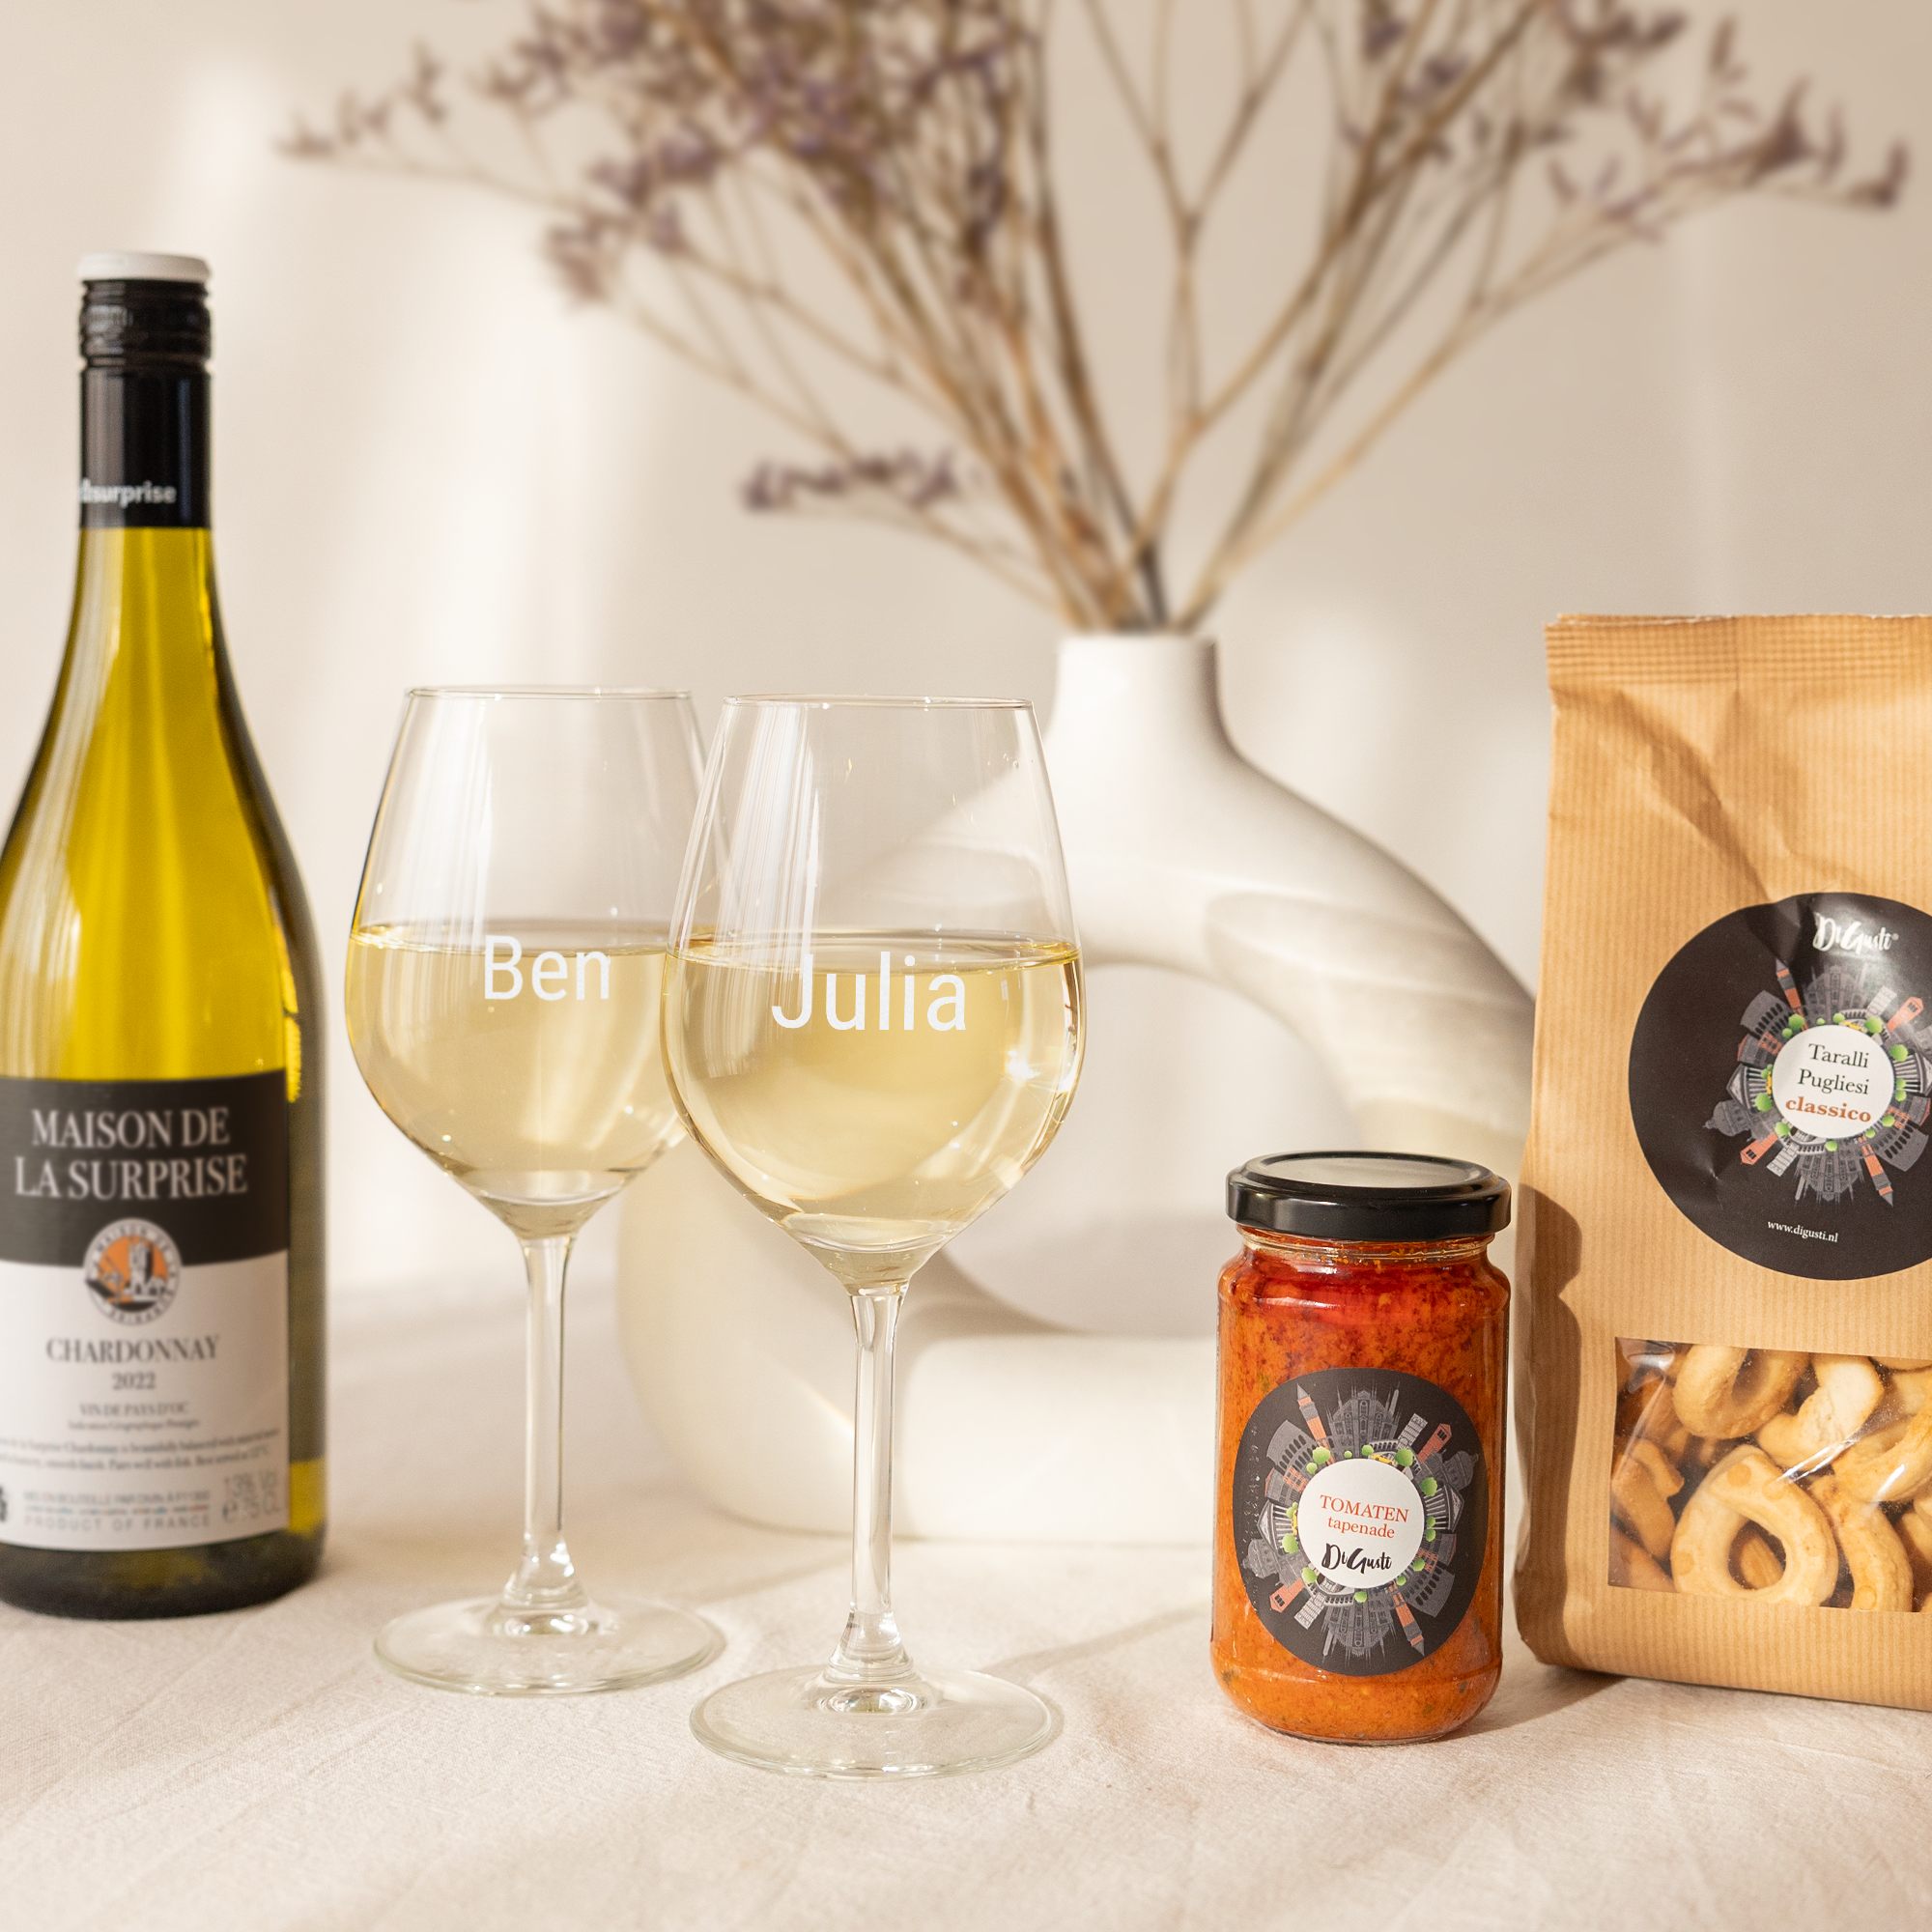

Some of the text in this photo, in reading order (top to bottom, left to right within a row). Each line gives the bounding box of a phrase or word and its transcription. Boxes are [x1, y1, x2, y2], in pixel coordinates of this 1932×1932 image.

[484, 934, 611, 1002] Ben
[771, 950, 968, 1033] Julia
[1807, 1042, 1870, 1069] Taralli
[1797, 1068, 1870, 1095] Pugliesi
[1785, 1095, 1872, 1123] classico
[31, 1106, 231, 1150] MAISON DE
[14, 1152, 249, 1201] LA SURPRISE
[1767, 1218, 1839, 1243] www.digusti.nl
[45, 1333, 220, 1364] CHARDONNAY
[111, 1371, 156, 1391] 2022
[1320, 1493, 1409, 1523] TOMATEN
[24, 1513, 210, 1533] PRODUCT OF FRANCE
[1327, 1515, 1396, 1540] tapenade
